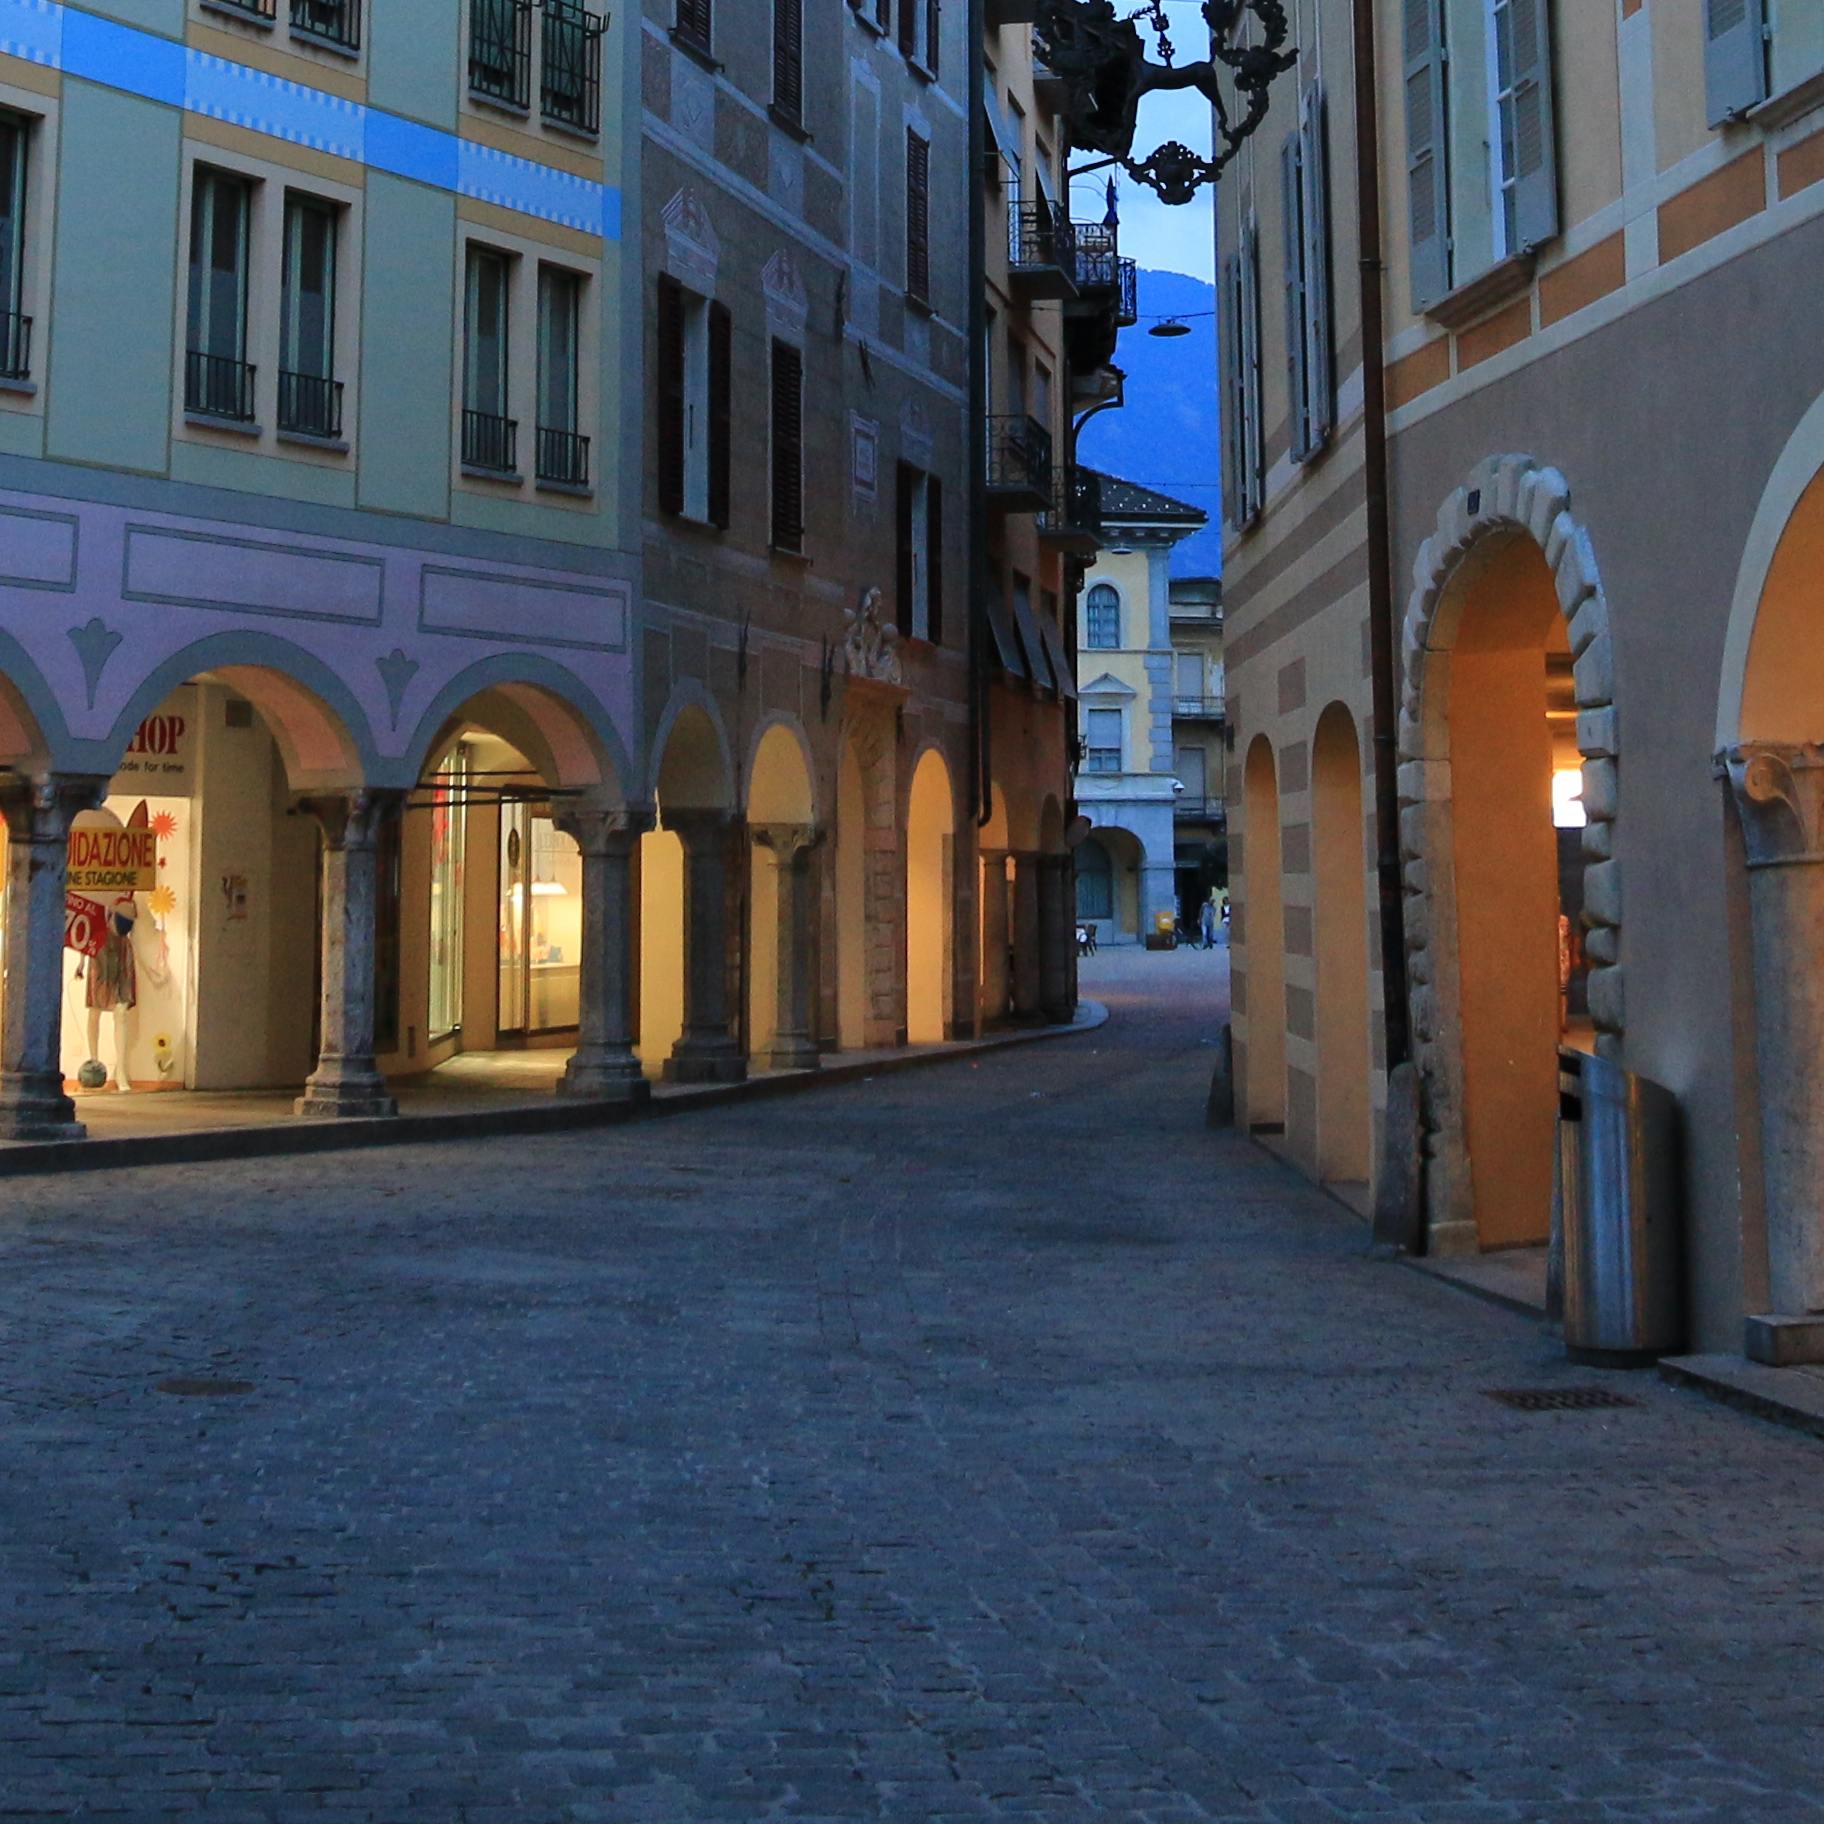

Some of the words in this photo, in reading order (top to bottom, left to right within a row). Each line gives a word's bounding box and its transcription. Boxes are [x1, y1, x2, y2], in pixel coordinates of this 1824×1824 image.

[144, 761, 158, 773] for
[162, 762, 185, 774] time
[84, 871, 138, 886] STAGIONE
[85, 903, 96, 916] AL
